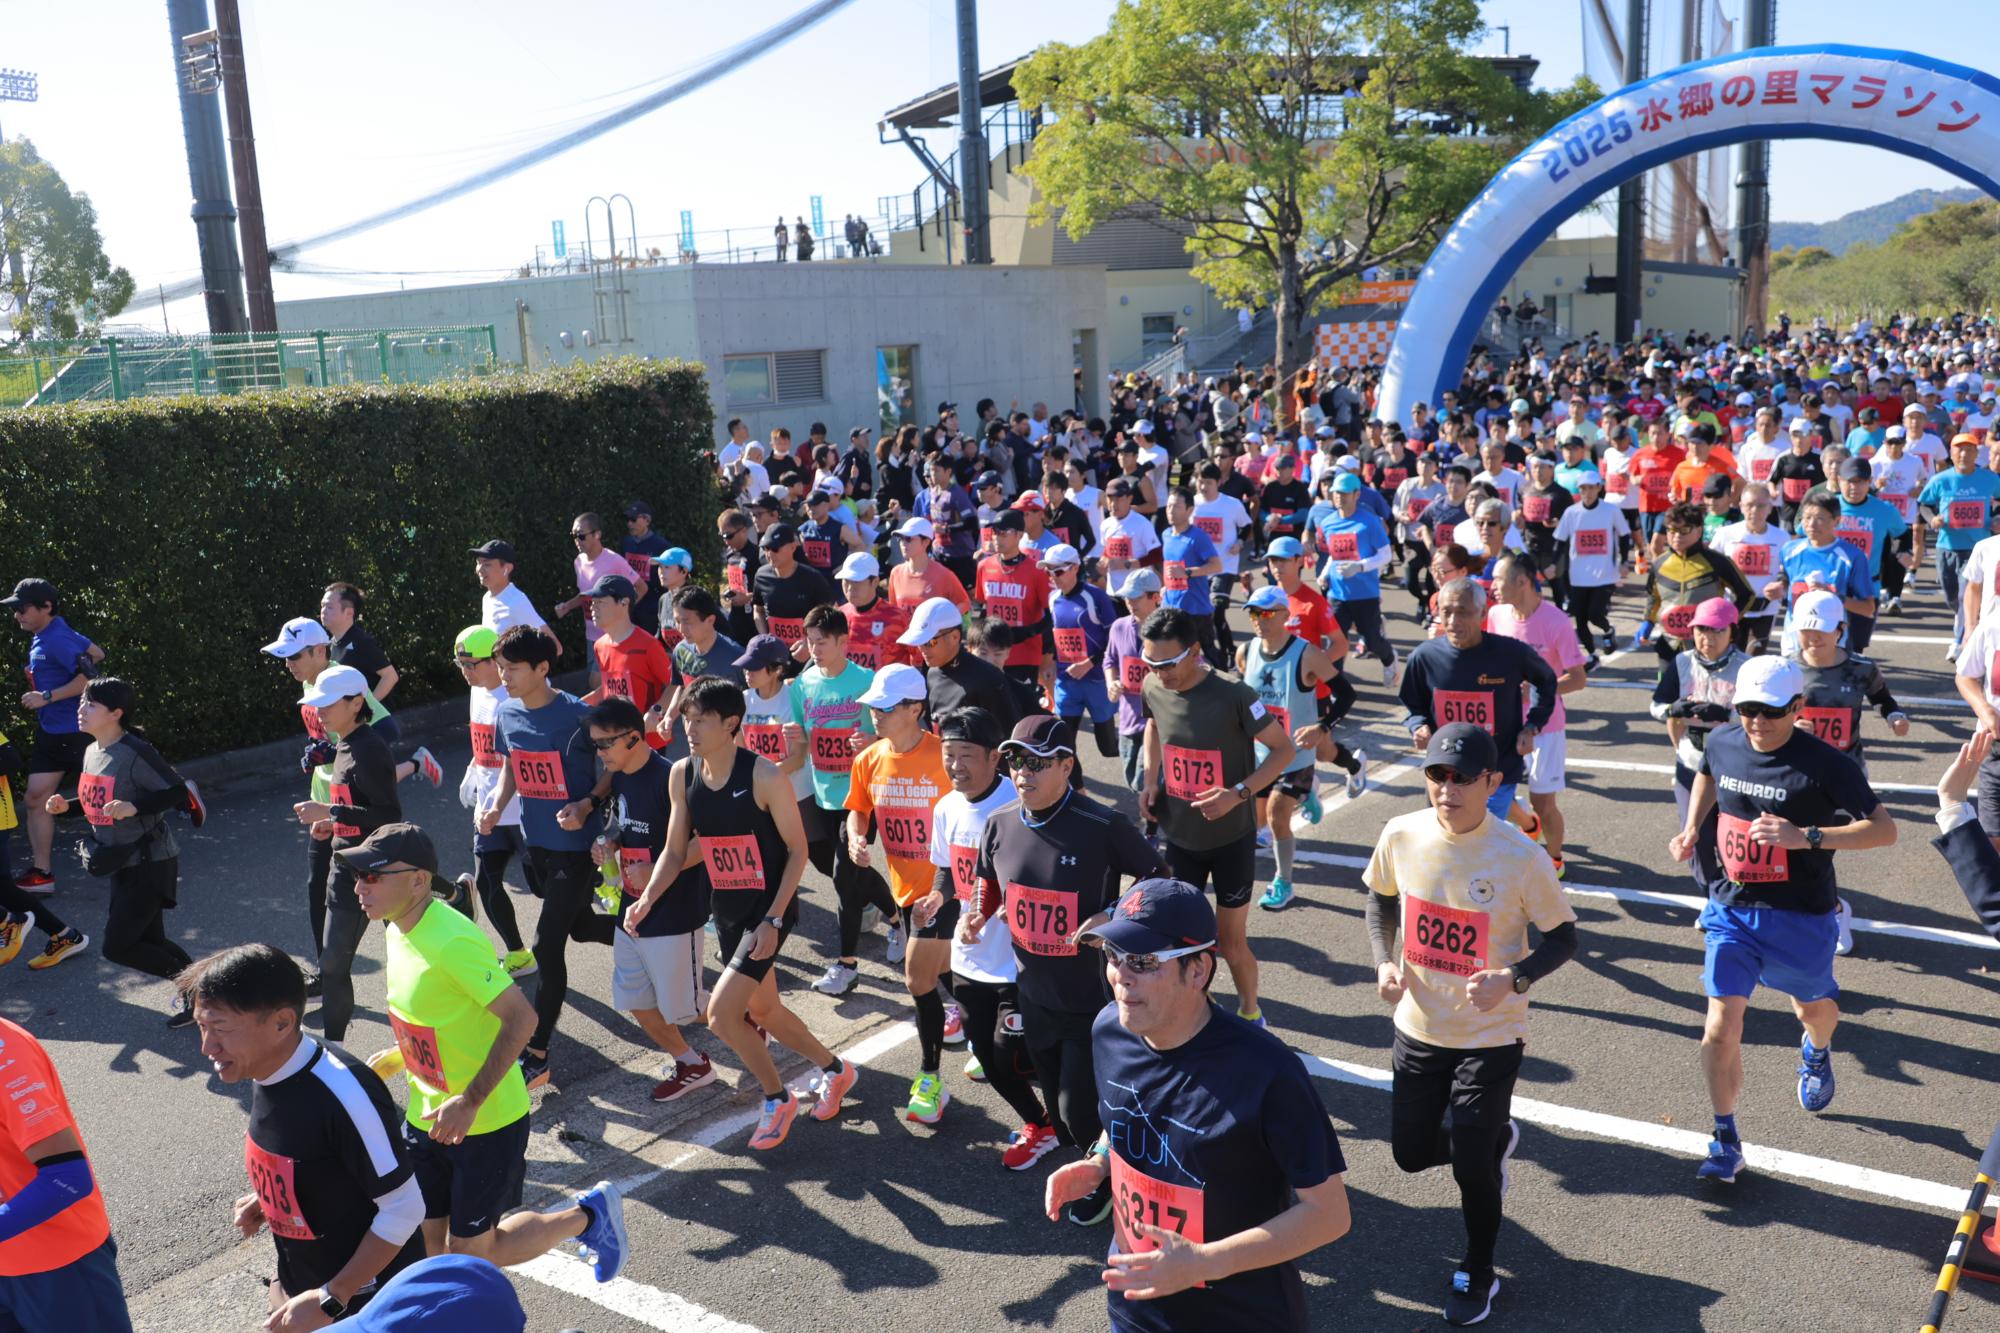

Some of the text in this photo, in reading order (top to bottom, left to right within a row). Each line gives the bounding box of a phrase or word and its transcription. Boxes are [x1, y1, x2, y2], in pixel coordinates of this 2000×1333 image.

[775, 622, 801, 639] 6638
[1444, 701, 1487, 724] 6166
[750, 733, 780, 755] 6482
[817, 736, 854, 758] 6239
[519, 760, 556, 785] 6161
[1172, 757, 1215, 786] 6173
[82, 783, 107, 809] 6423
[1719, 775, 1787, 802] HEIWADO
[885, 817, 928, 844] 6013
[712, 847, 756, 873] 6014
[1016, 898, 1068, 936] 6178
[1420, 902, 1471, 923] DAISHIN
[1417, 914, 1477, 958] 6262
[1110, 1120, 1169, 1168] FUJI
[250, 1157, 292, 1215] 6213
[1121, 1163, 1177, 1203] DAISHIN
[1120, 1182, 1188, 1248] 6317
